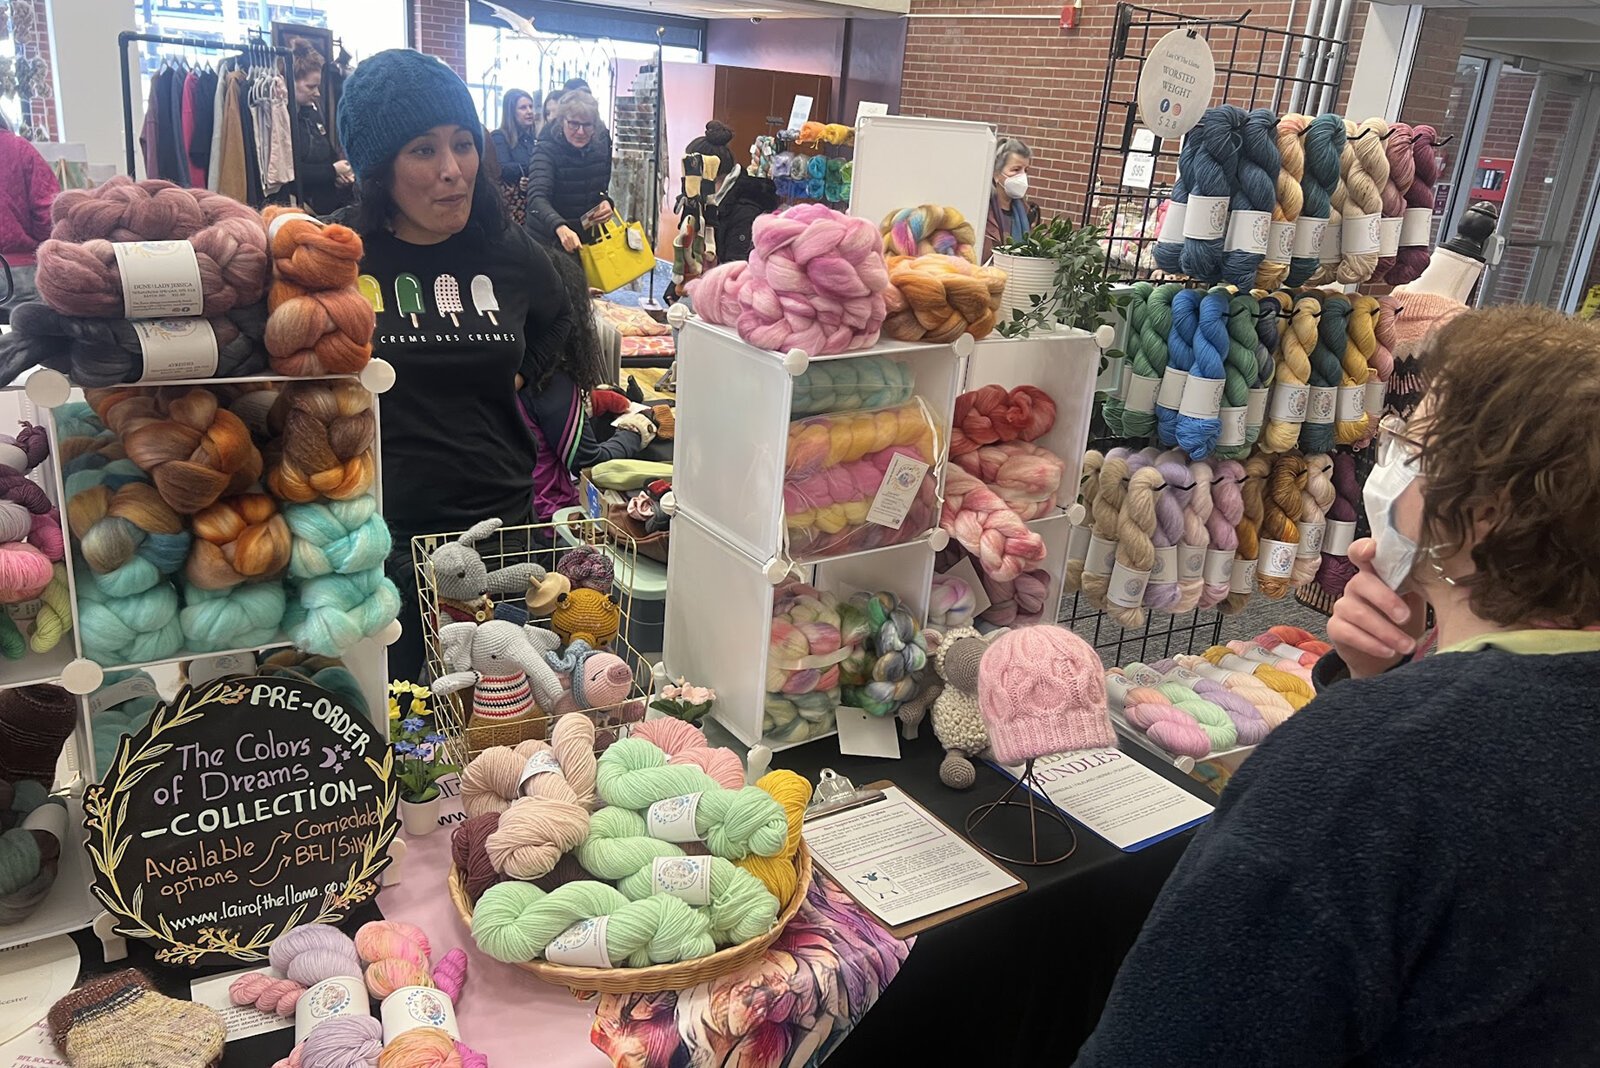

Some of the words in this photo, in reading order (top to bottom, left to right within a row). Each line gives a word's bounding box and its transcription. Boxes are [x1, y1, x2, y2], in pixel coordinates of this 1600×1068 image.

[1162, 80, 1193, 99] WEIGHT
[1163, 65, 1196, 85] WORSTED
[380, 334, 427, 344] CREME
[435, 333, 460, 342] DES
[468, 333, 516, 343] CREMES
[249, 683, 371, 757] PRE-ORDER
[176, 742, 225, 772] The
[235, 729, 311, 763] Colors
[153, 776, 184, 806] of
[201, 762, 310, 801] Dreams
[145, 837, 255, 883] Available
[294, 802, 381, 841] Corriedale
[160, 871, 239, 904] options
